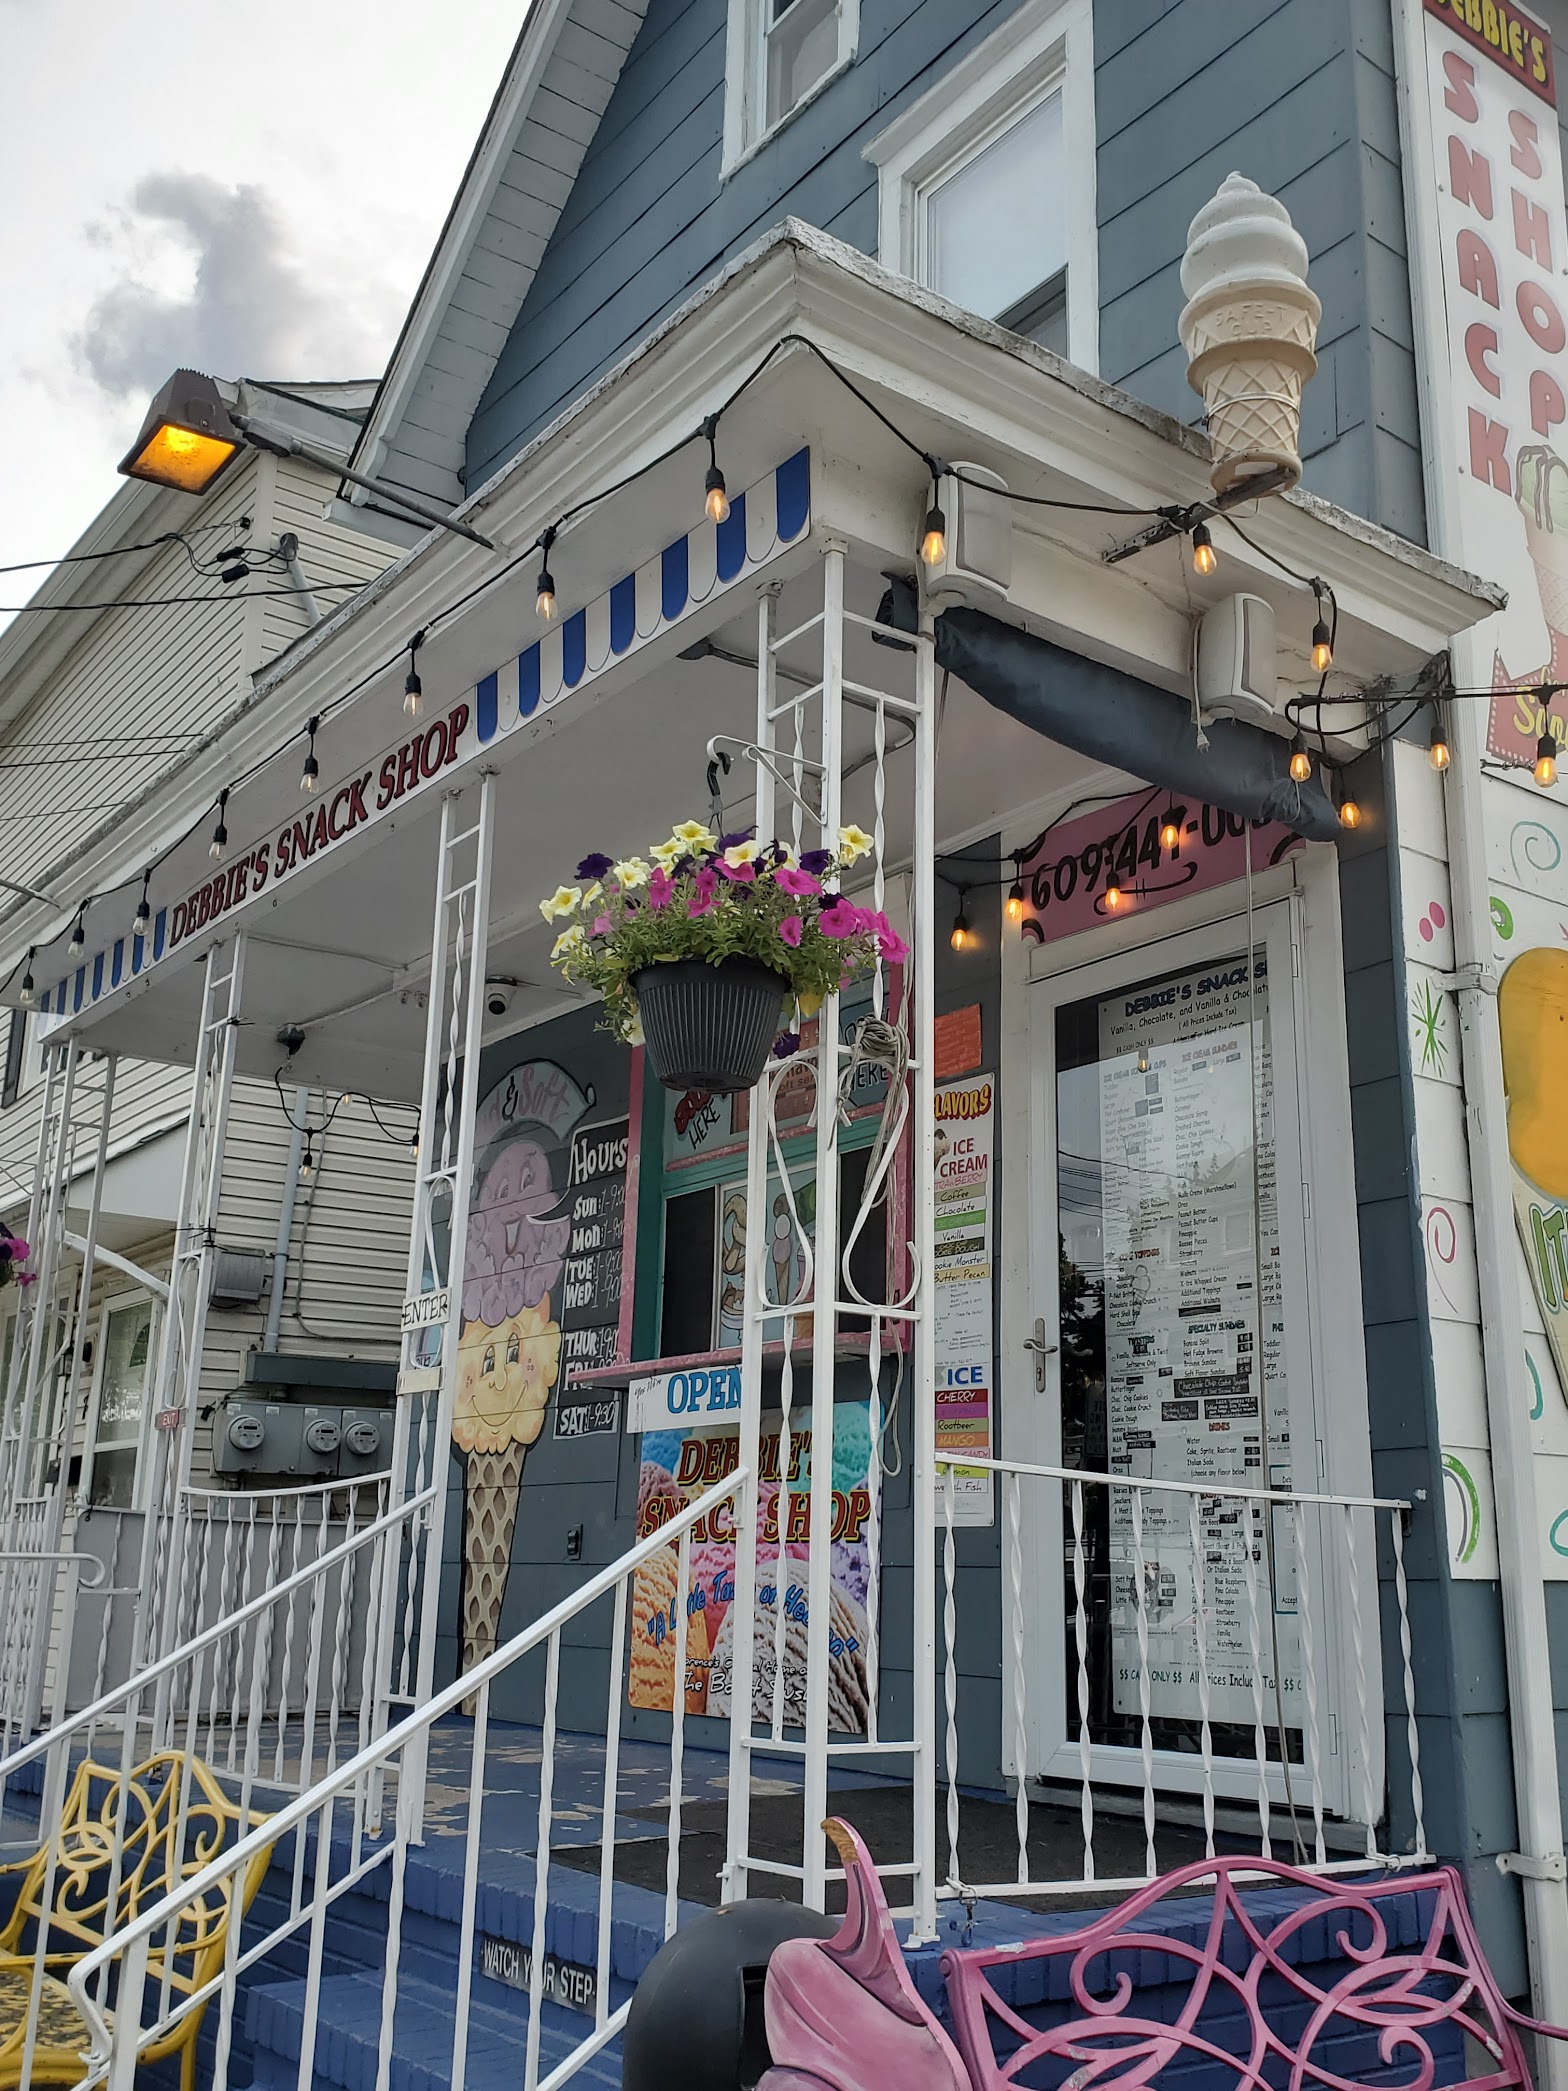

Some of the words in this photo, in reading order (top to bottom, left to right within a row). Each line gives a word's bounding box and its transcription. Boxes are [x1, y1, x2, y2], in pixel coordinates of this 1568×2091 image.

[1437, 0, 1547, 84] EBBIE'S
[1442, 51, 1513, 498] SNACK
[1507, 109, 1567, 440] SHOP
[169, 843, 270, 948] DEBBIE'S
[273, 771, 373, 878] SNACK
[376, 703, 469, 811] SHOP
[1125, 984, 1192, 1018] DEBBIE'S
[1196, 965, 1249, 997] SNACK
[1109, 1021, 1137, 1036] Vanilla,
[1138, 1011, 1176, 1028] Chocolate,
[1179, 1003, 1193, 1017] and
[1195, 994, 1221, 1013] Vanilla
[934, 1084, 992, 1120] LAVORS
[687, 1097, 721, 1150] HERE
[952, 1137, 975, 1156] ICE
[573, 1137, 629, 1185] Hours
[939, 1154, 989, 1178] CREAM
[934, 1172, 984, 1190] TRAWBERRY
[940, 1188, 970, 1202] Coffee
[936, 1200, 976, 1217] Chocolate
[942, 1228, 965, 1242] Vanilla
[934, 1259, 952, 1270] ookie
[954, 1255, 985, 1267] Monster
[1530, 1207, 1568, 1307] IT
[934, 1272, 960, 1284] Butter
[963, 1268, 986, 1279] Pecan
[402, 1292, 448, 1327] ENTER
[1187, 1321, 1217, 1335] SPECIALTY
[947, 1365, 984, 1386] ICE
[936, 1390, 976, 1403] CHERRY
[937, 1419, 975, 1431] Rootbeer
[938, 1435, 976, 1446] MANGO
[943, 1465, 970, 1475] Lmon
[965, 1481, 982, 1491] Fish
[685, 1656, 720, 1669] orence's
[684, 1670, 703, 1692] The
[711, 1673, 762, 1697] Bot
[1119, 1669, 1129, 1681] $$
[1151, 1671, 1171, 1682] ONLY
[1173, 1671, 1182, 1684] $$
[1206, 1674, 1227, 1687] rices
[483, 1940, 519, 1980] WATCH
[559, 1965, 594, 2005] STEP
